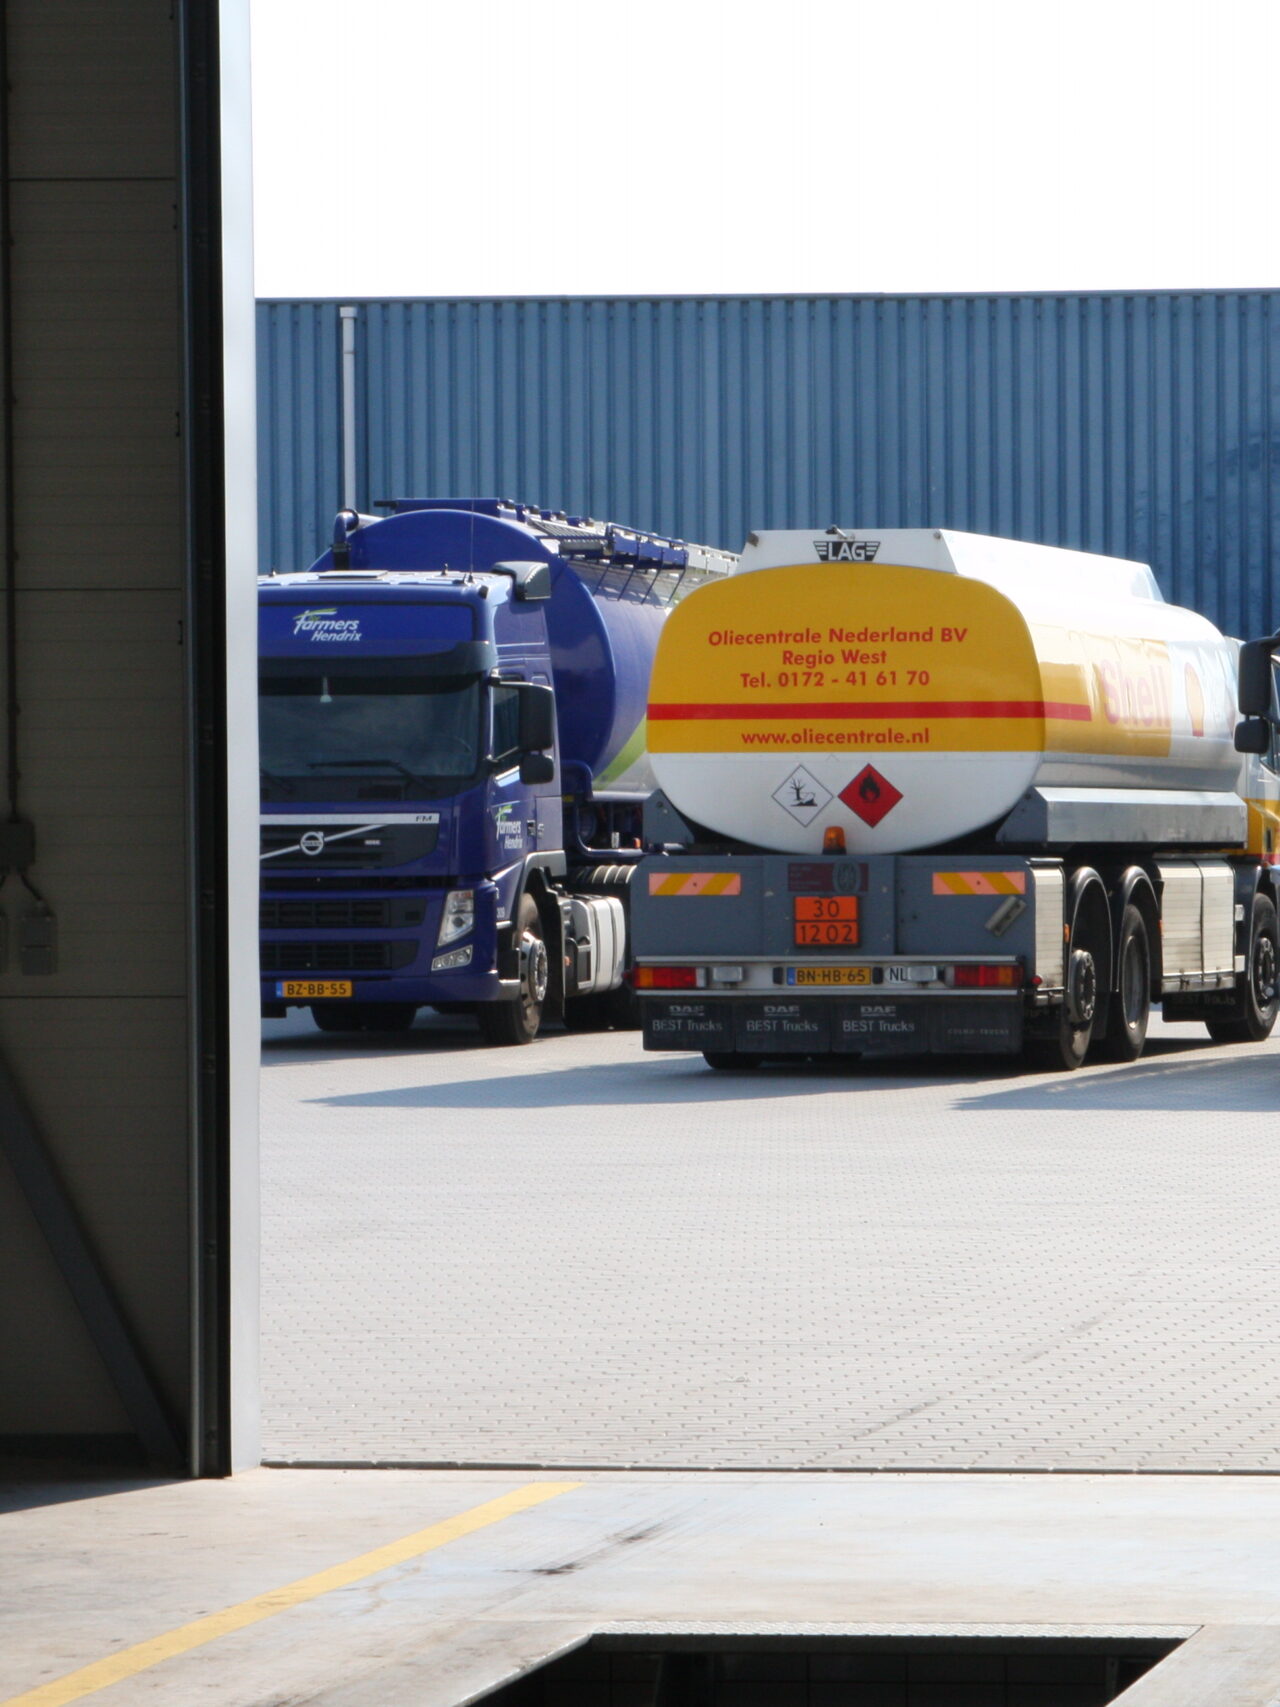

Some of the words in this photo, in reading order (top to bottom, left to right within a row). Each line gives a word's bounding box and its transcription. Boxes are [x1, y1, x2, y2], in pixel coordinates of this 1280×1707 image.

[828, 541, 866, 561] LAG
[311, 631, 362, 641] Hendrix
[708, 628, 821, 646] Oliecentrale
[829, 627, 933, 644] Nederland
[940, 627, 968, 643] BV
[782, 649, 835, 668] Regio
[841, 649, 887, 665] West
[740, 672, 772, 688] Tel.
[778, 671, 824, 688] 0172
[846, 671, 867, 687] 41
[876, 671, 897, 687] 61
[906, 670, 930, 686] 70
[1100, 660, 1170, 729] Shell
[741, 728, 930, 744] www.oliecentrale.nl
[813, 900, 840, 918] 30
[800, 924, 853, 943] 1202
[796, 969, 866, 982] BN-HB-65
[889, 967, 907, 981] NL
[287, 983, 347, 995] BZ-BB-55
[669, 1005, 705, 1013] DAF
[764, 1005, 800, 1013] DAF
[861, 1005, 896, 1013] DAF
[652, 1020, 683, 1031] BEST
[687, 1020, 723, 1032] Trucks
[746, 1020, 777, 1031] BEST
[782, 1020, 818, 1032] Trucks
[842, 1020, 874, 1032] BEST
[878, 1020, 915, 1032] Trucks
